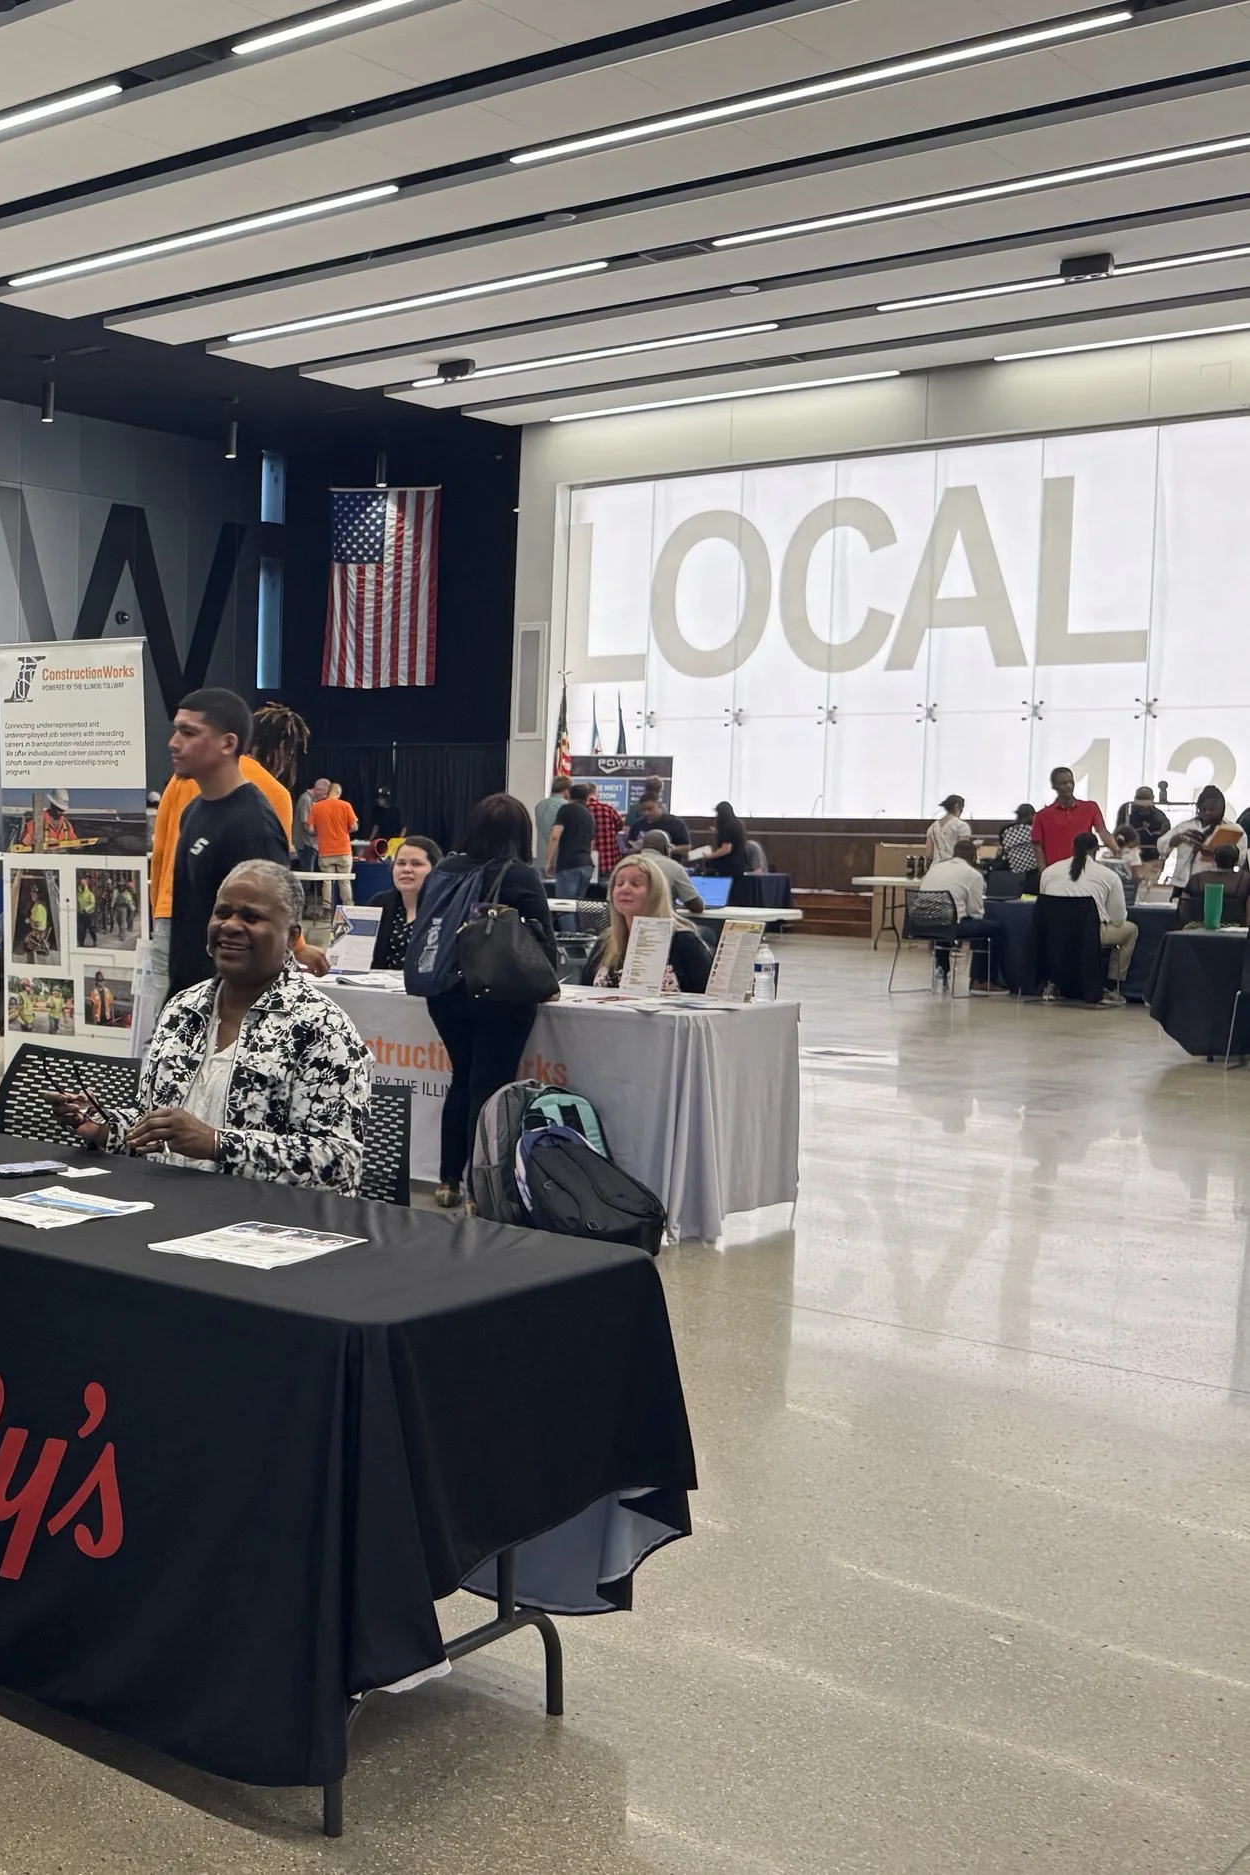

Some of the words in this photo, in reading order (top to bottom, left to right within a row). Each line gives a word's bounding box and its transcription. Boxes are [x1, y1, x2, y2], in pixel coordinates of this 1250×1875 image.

[569, 476, 1148, 682] LOCAL
[42, 665, 134, 681] ConstructionWorks
[83, 682, 102, 690] ILLINOIS
[5, 722, 35, 730] Connecting
[5, 731, 48, 739] underemployed
[49, 731, 59, 739] job
[95, 730, 125, 738] rewarding
[87, 750, 113, 758] coaching
[97, 758, 119, 767] training
[598, 758, 645, 769] POWER
[422, 1081, 450, 1097] ILLI
